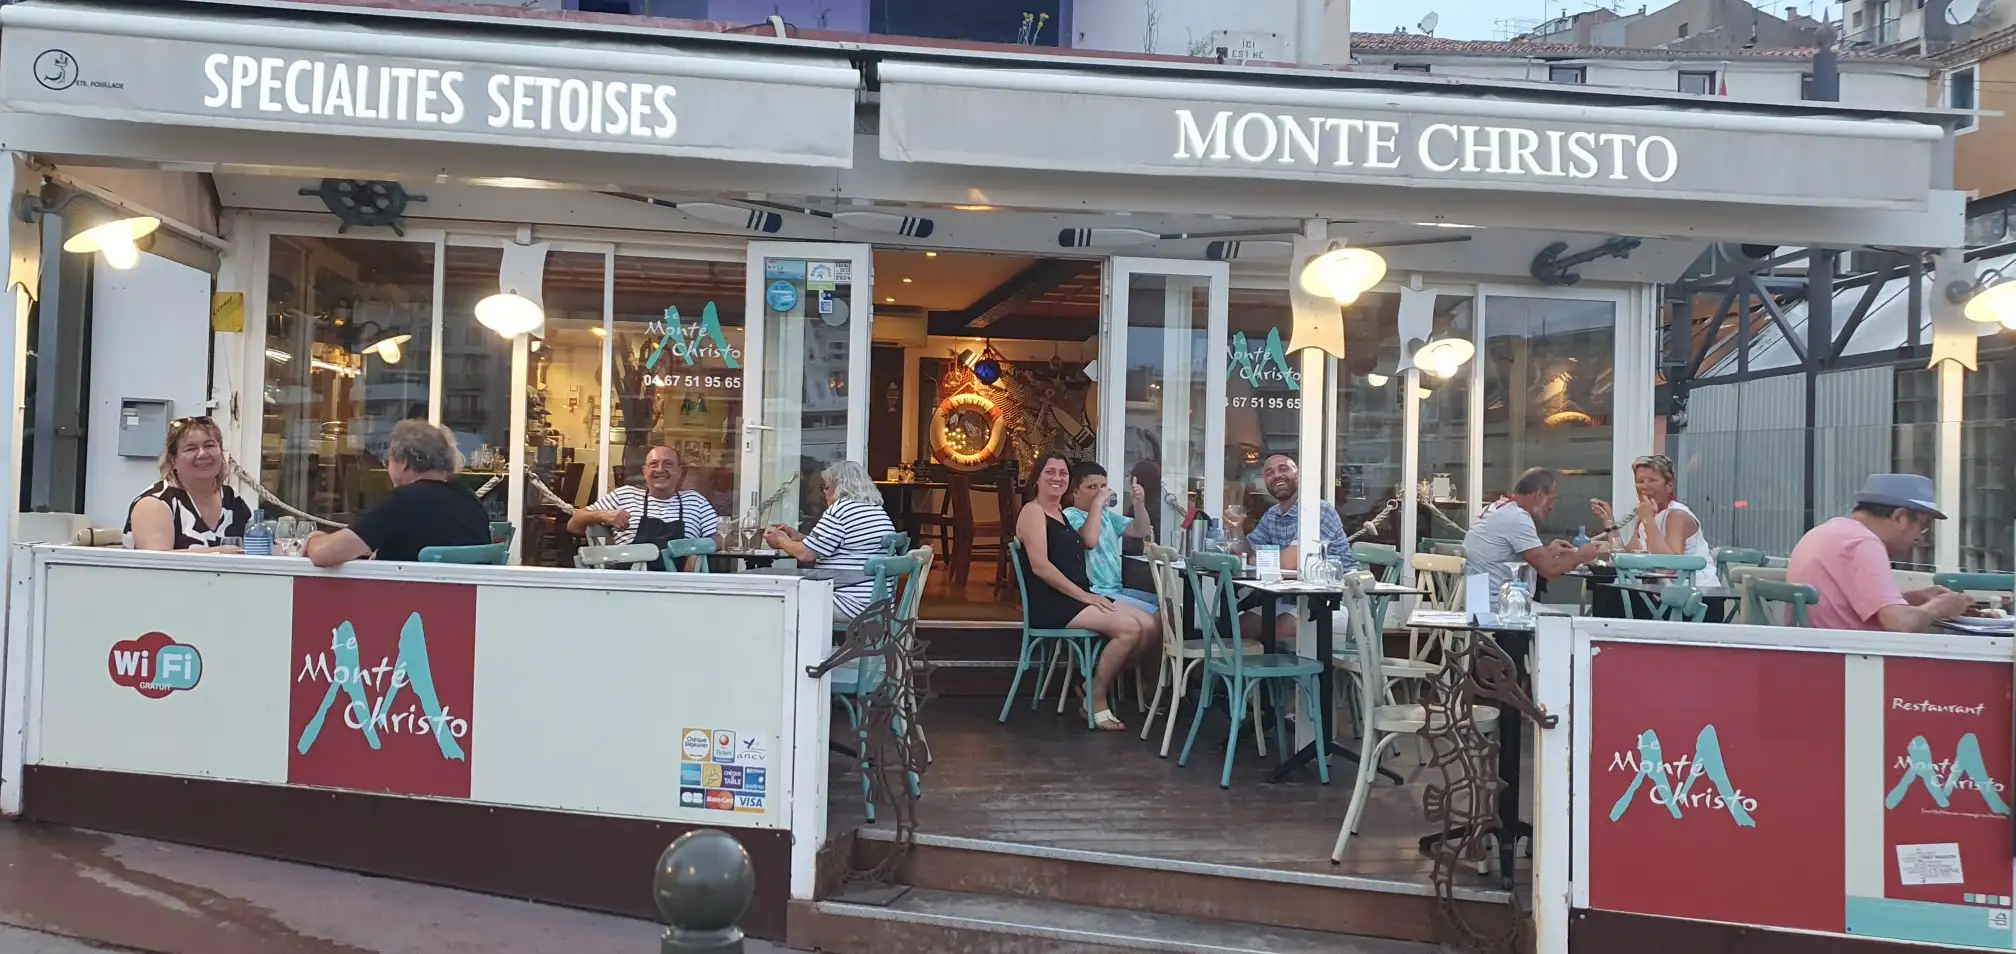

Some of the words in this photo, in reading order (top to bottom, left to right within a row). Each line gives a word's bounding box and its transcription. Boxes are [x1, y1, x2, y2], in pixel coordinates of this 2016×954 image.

[204, 53, 464, 125] SPECIALITES
[487, 74, 678, 138] SETOISES
[1173, 109, 1400, 169] MONTE
[1418, 123, 1678, 183] CHRISTO
[664, 308, 680, 320] Le
[645, 319, 709, 338] Monté
[672, 341, 741, 359] Christo
[664, 375, 680, 387] 67
[684, 376, 700, 387] 51
[705, 377, 721, 388] 95
[725, 377, 741, 388] 65
[1240, 364, 1301, 381] Christo
[1232, 397, 1247, 408] 67
[1250, 397, 1264, 409] 51
[1268, 398, 1283, 409] 95
[1286, 398, 1300, 409] 65
[330, 628, 357, 650] Le
[113, 650, 149, 677] Wi
[162, 653, 192, 680] Fi
[297, 652, 410, 692] Monté
[140, 681, 171, 691] GRATUIT
[1892, 697, 1986, 716] Restaurant
[344, 697, 468, 742] Christo
[1637, 734, 1660, 750] Le
[1608, 750, 1706, 779] Monté
[724, 777, 742, 785] TABLE
[1930, 774, 2005, 792] Christo
[740, 796, 763, 807] VISA
[1650, 782, 1758, 816] Christo
